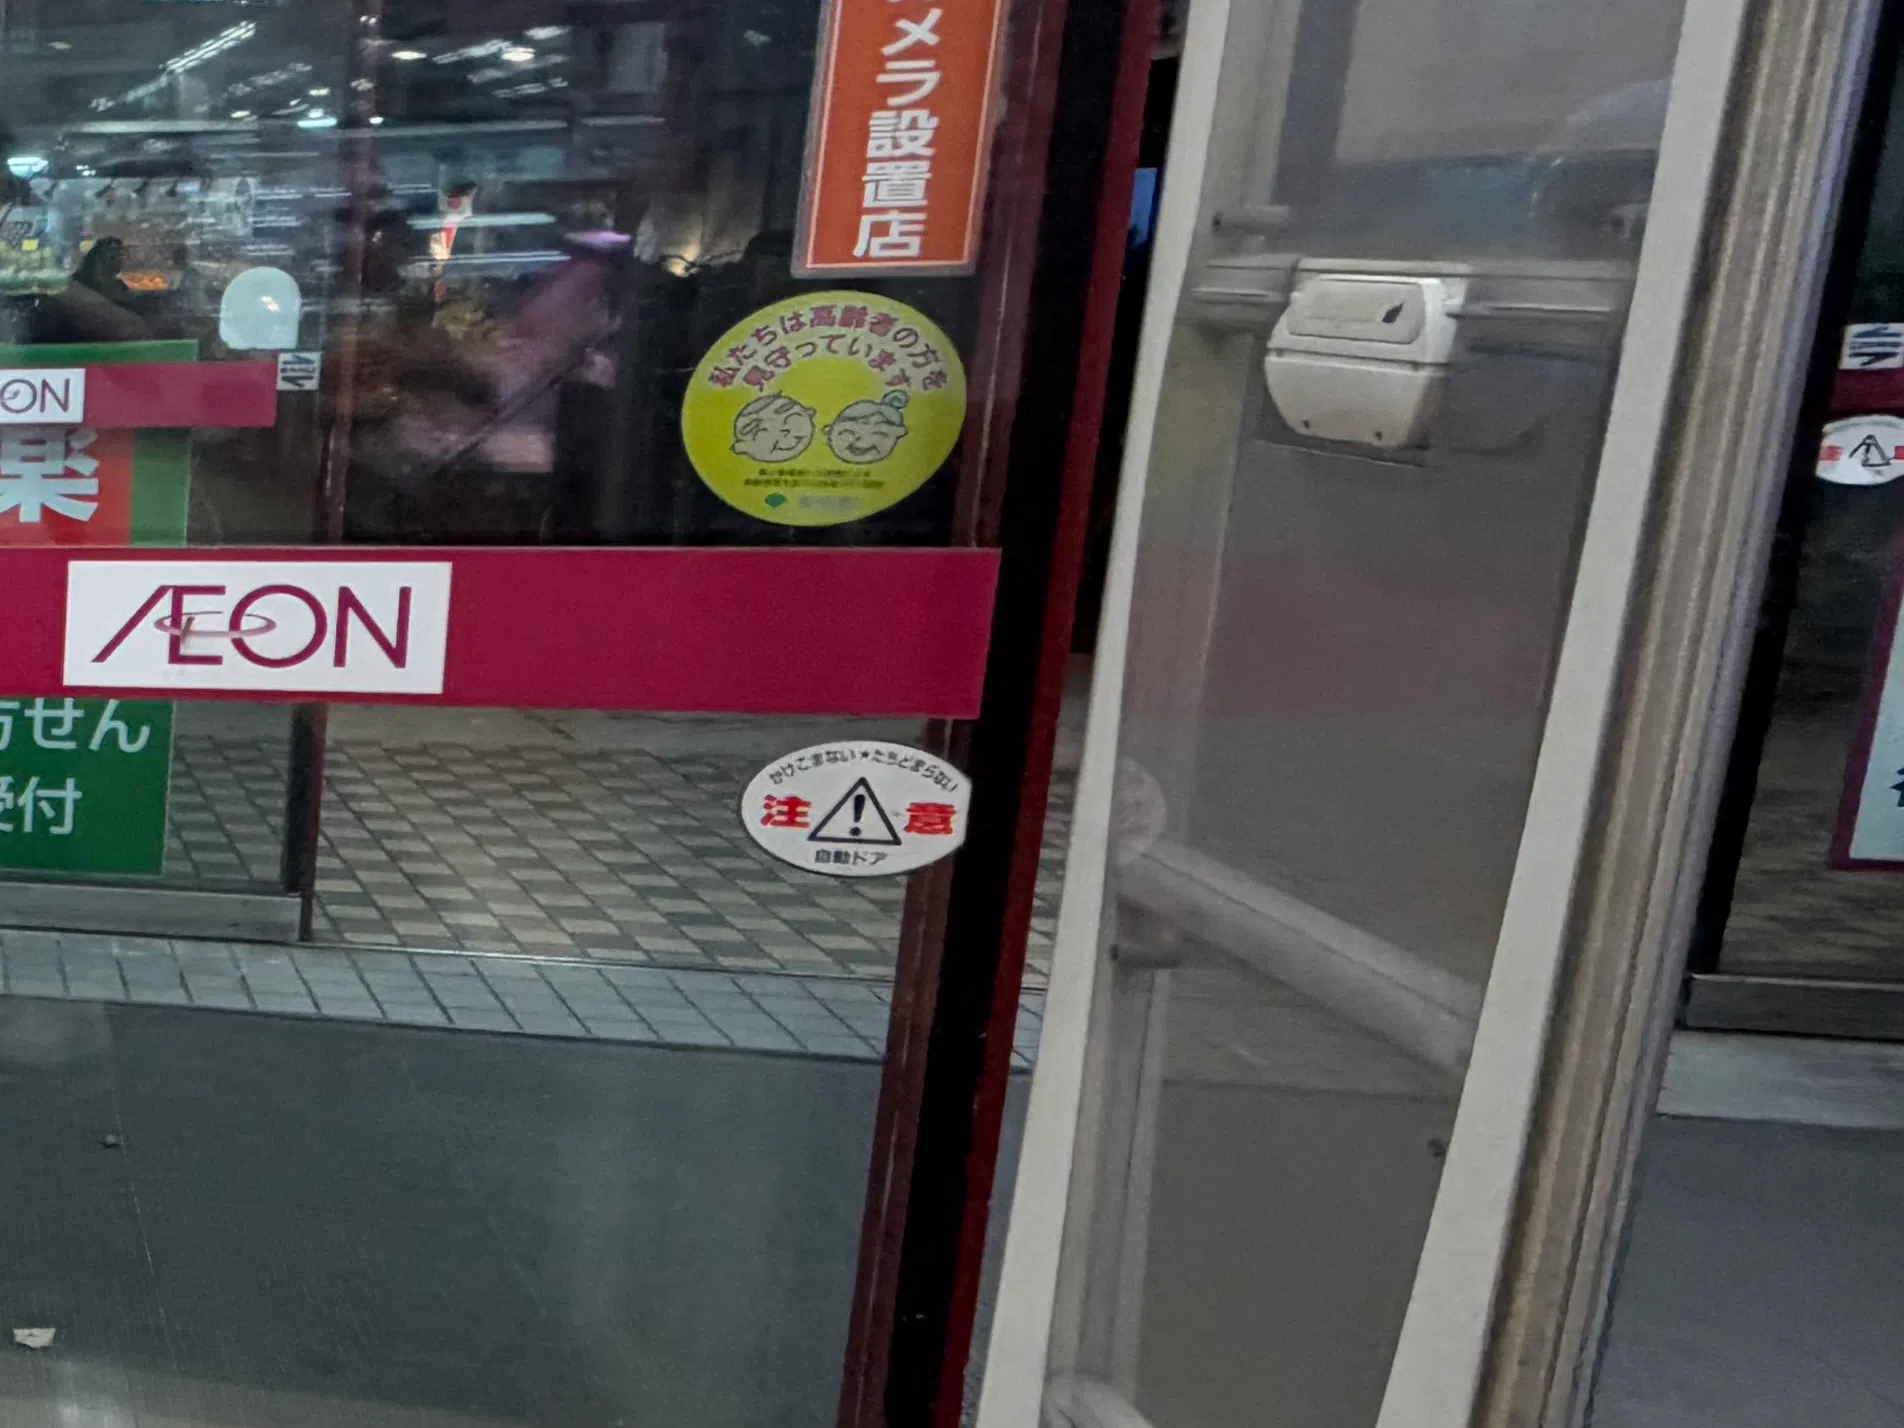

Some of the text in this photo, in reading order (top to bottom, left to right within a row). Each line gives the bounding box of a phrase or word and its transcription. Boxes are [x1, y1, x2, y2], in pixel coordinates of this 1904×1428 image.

[707, 305, 949, 391] 私たちは高齢者の方を
[743, 333, 912, 392] 見守っています
[814, 848, 889, 866] 自動ドア
